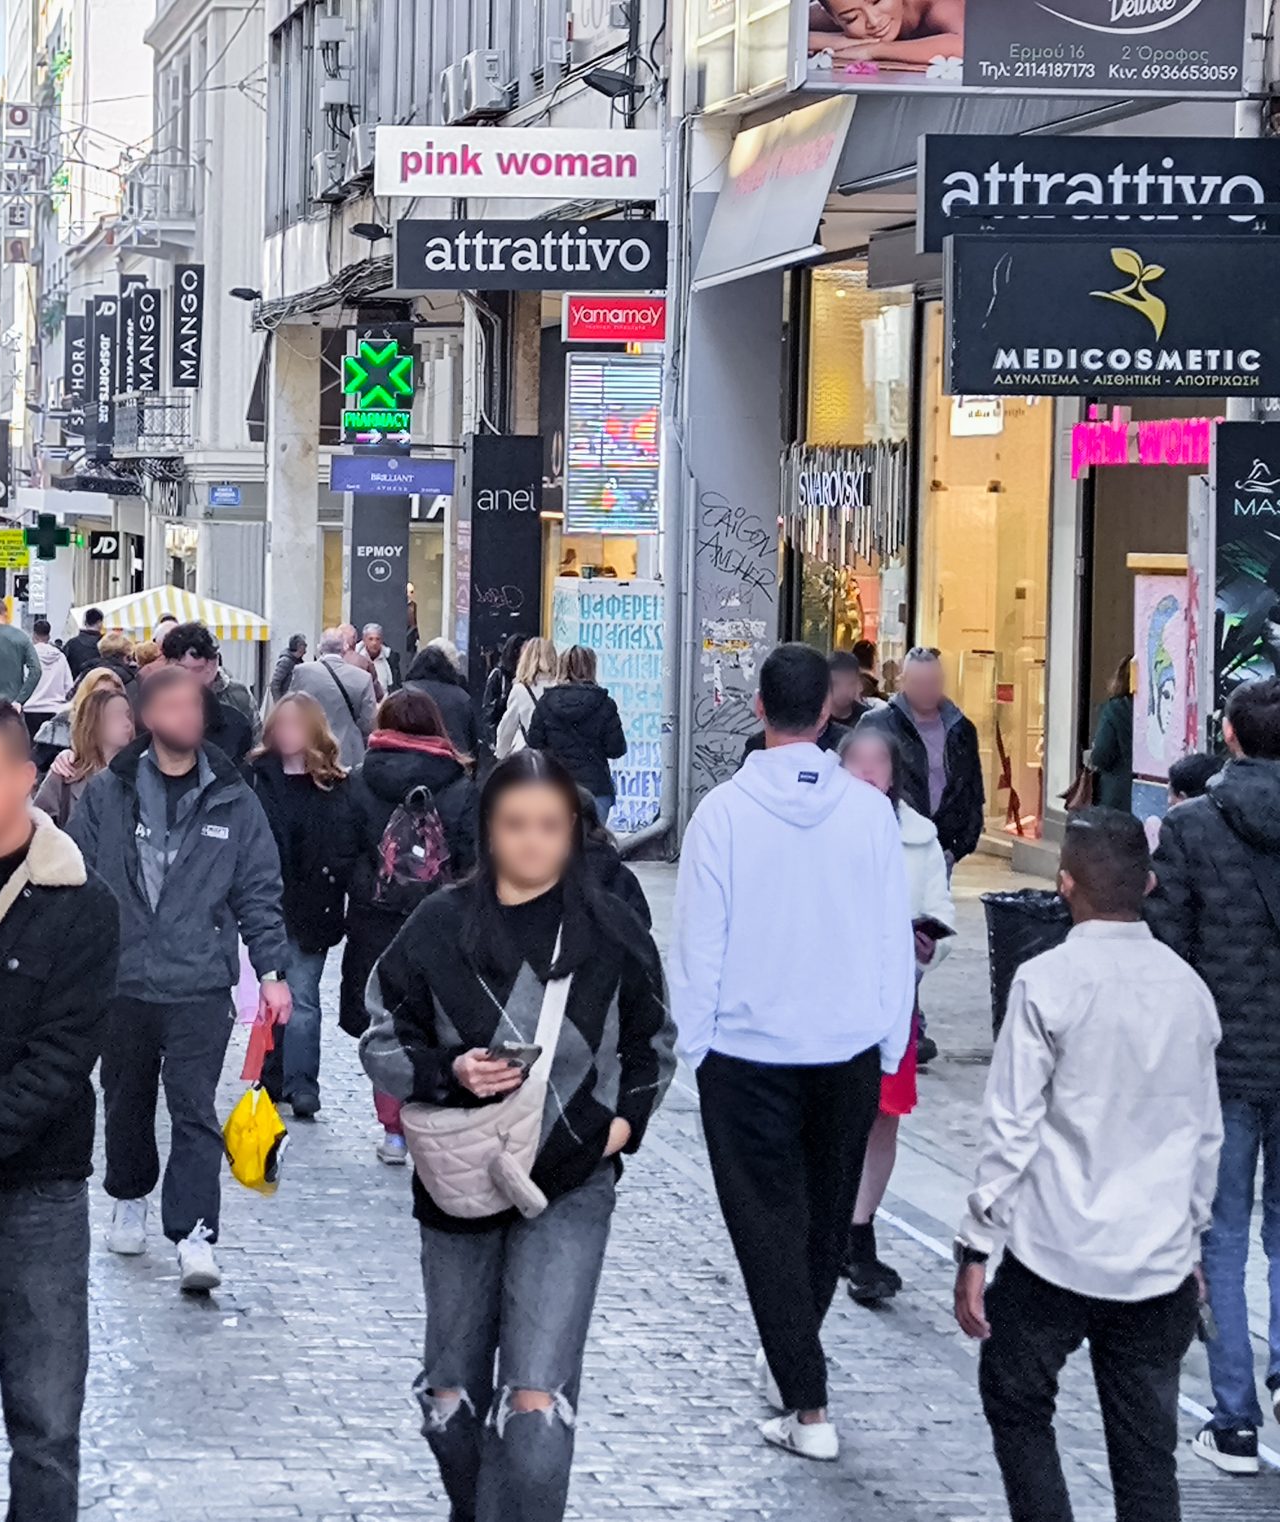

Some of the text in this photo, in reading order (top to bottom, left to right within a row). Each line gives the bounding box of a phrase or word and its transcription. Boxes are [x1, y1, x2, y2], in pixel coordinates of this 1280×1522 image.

[1009, 44, 1085, 60] Ερμού 16
[1122, 46, 1209, 64] 2 Όροφος
[979, 61, 1096, 80] Τηλ: 2114187173
[1141, 64, 1238, 80] 6936653059
[400, 141, 637, 183] pink woman
[941, 157, 1265, 222] attrattivo
[424, 226, 651, 272] attrattivo
[180, 270, 198, 380] MANGO
[571, 304, 662, 327] yamamay
[139, 294, 155, 391] MANGO
[992, 348, 1261, 371] MEDICOSMETIC
[72, 337, 85, 426] SEHORA
[993, 373, 1259, 387] ΑΔΥΝΑΤΙΣΜΑ ΑΙΣΘΗΤΙΚΗ ΑΠΟΤΡΙΧΩΣΗ
[345, 413, 410, 428] PHARMACY
[799, 470, 864, 507] SWAROVSKI
[93, 536, 117, 554] JD
